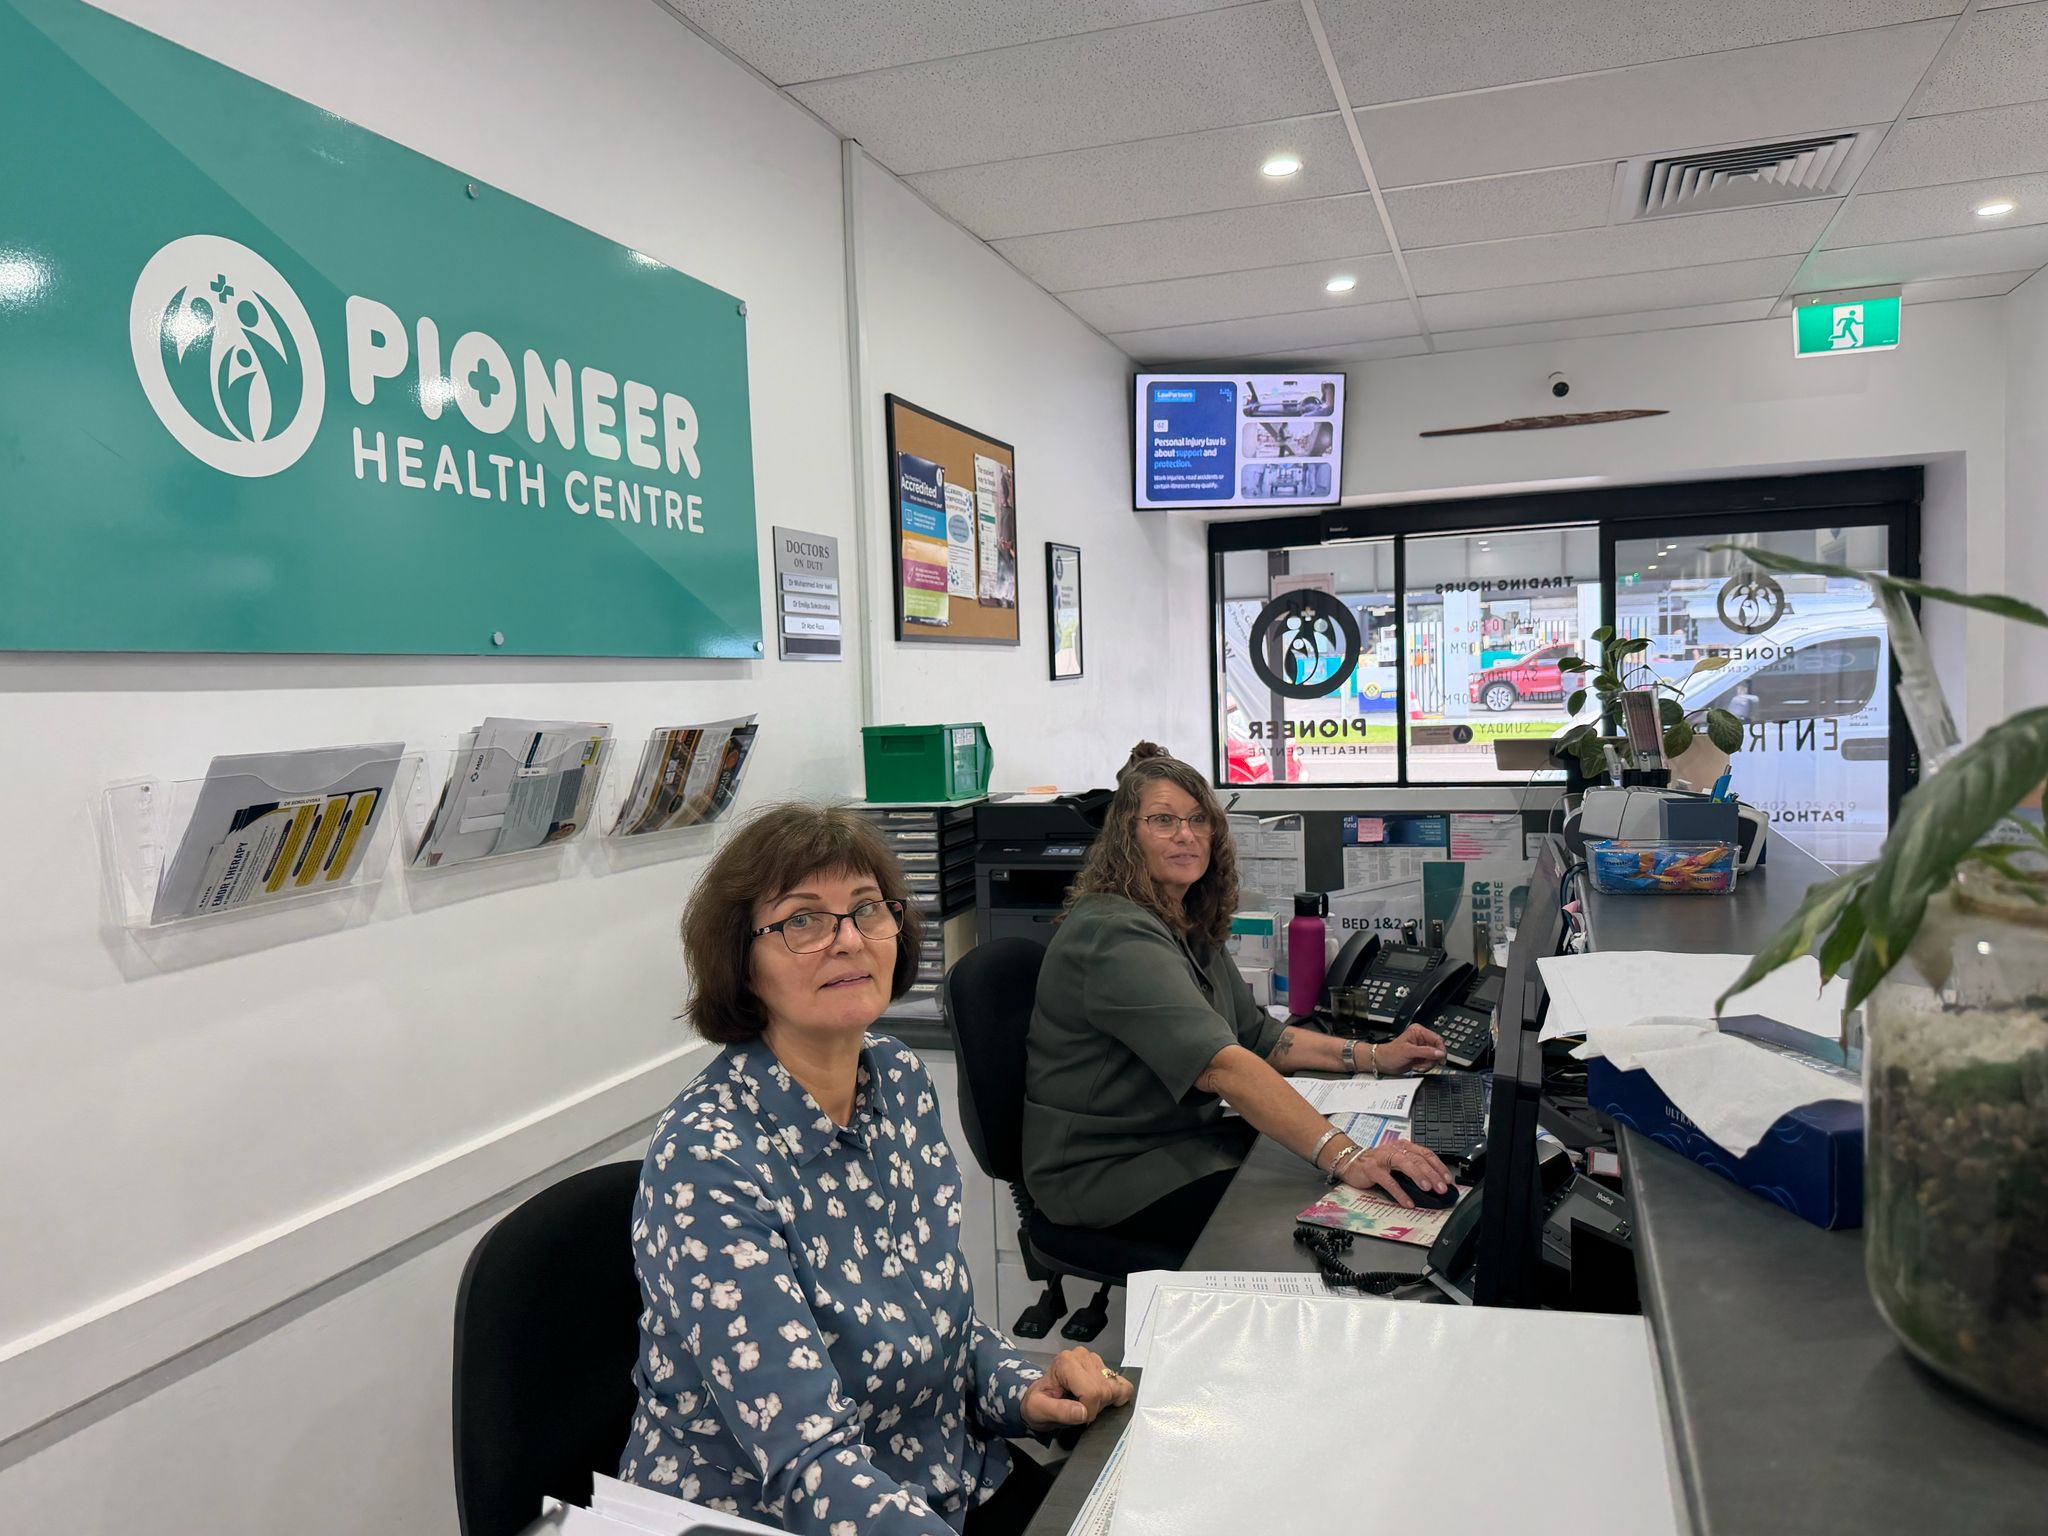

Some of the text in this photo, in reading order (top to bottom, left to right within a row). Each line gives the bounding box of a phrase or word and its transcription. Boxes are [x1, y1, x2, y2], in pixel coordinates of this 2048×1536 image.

[346, 295, 701, 479] PIONEER
[1154, 437, 1226, 448] Personal injury law is
[1154, 448, 1218, 459] about support and
[1154, 459, 1192, 470] protection.
[352, 427, 705, 534] HEALTH CENTRE
[902, 476, 937, 499] Accredited
[786, 540, 830, 559] DOCTORS
[794, 558, 823, 570] ON DUTY
[476, 755, 484, 771] MSD
[212, 842, 248, 906] EMDR THERAPY
[1494, 881, 1504, 932] CENTRE
[1342, 918, 1369, 930] BED
[1374, 917, 1401, 930] 1&2
